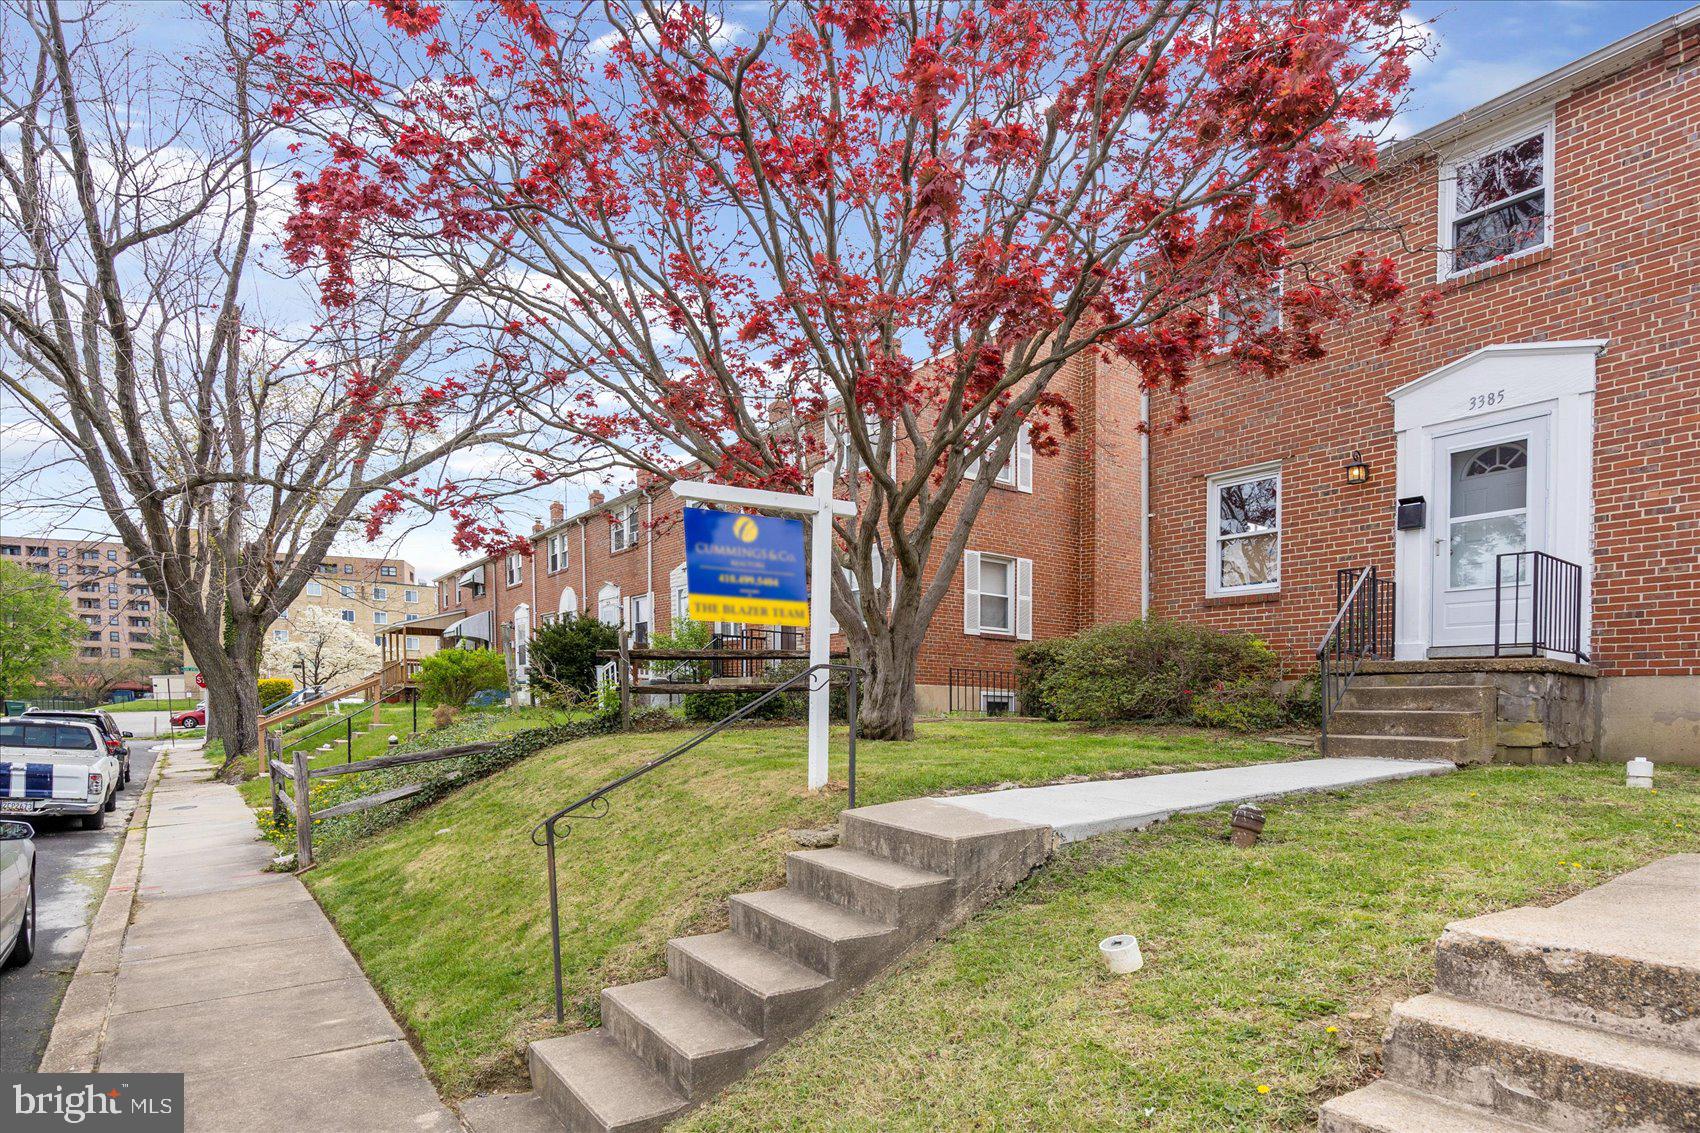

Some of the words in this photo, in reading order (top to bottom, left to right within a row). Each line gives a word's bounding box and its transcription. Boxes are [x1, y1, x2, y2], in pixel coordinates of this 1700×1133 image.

[1469, 389, 1505, 411] 3385
[695, 601, 718, 614] THE
[722, 604, 769, 617] BLAZER
[772, 607, 806, 619] TEAM
